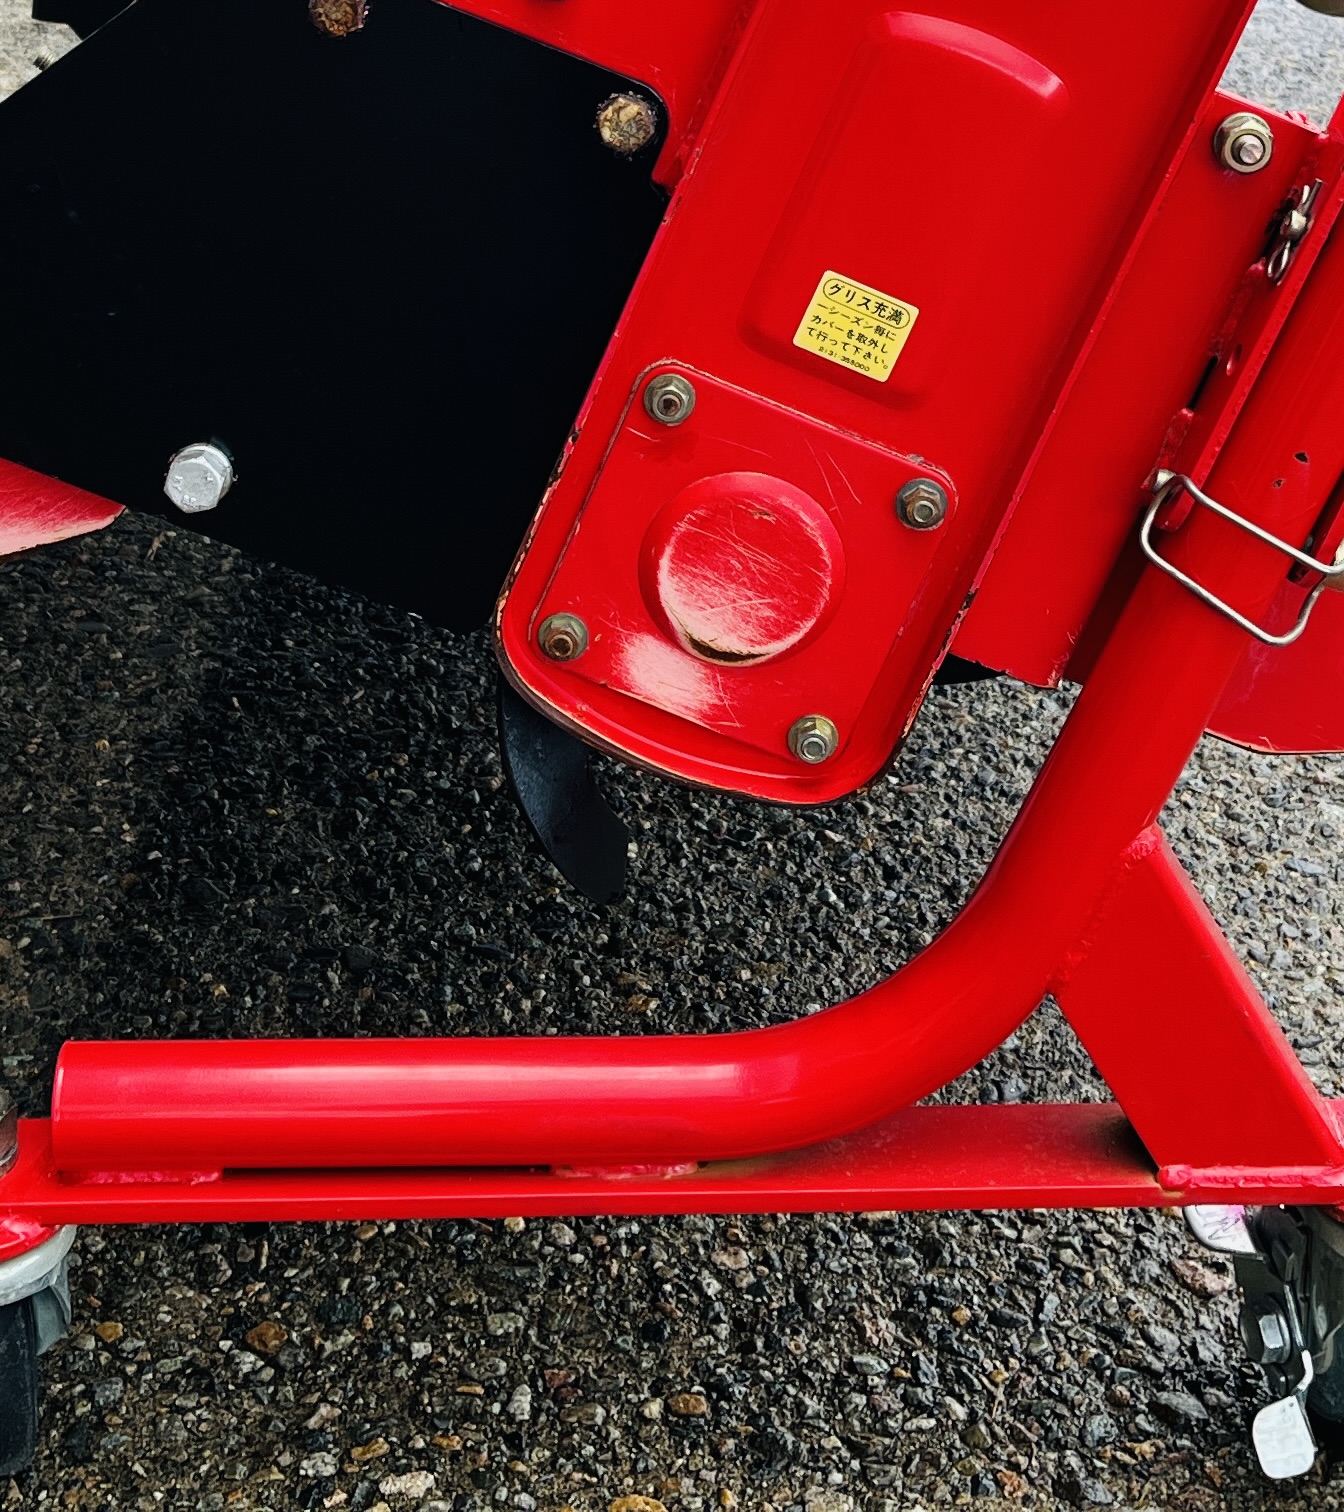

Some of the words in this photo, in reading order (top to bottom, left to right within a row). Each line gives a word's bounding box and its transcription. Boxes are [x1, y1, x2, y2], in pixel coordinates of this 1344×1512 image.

[828, 283, 905, 325] グリス充満
[810, 314, 888, 354] カバーを取外し
